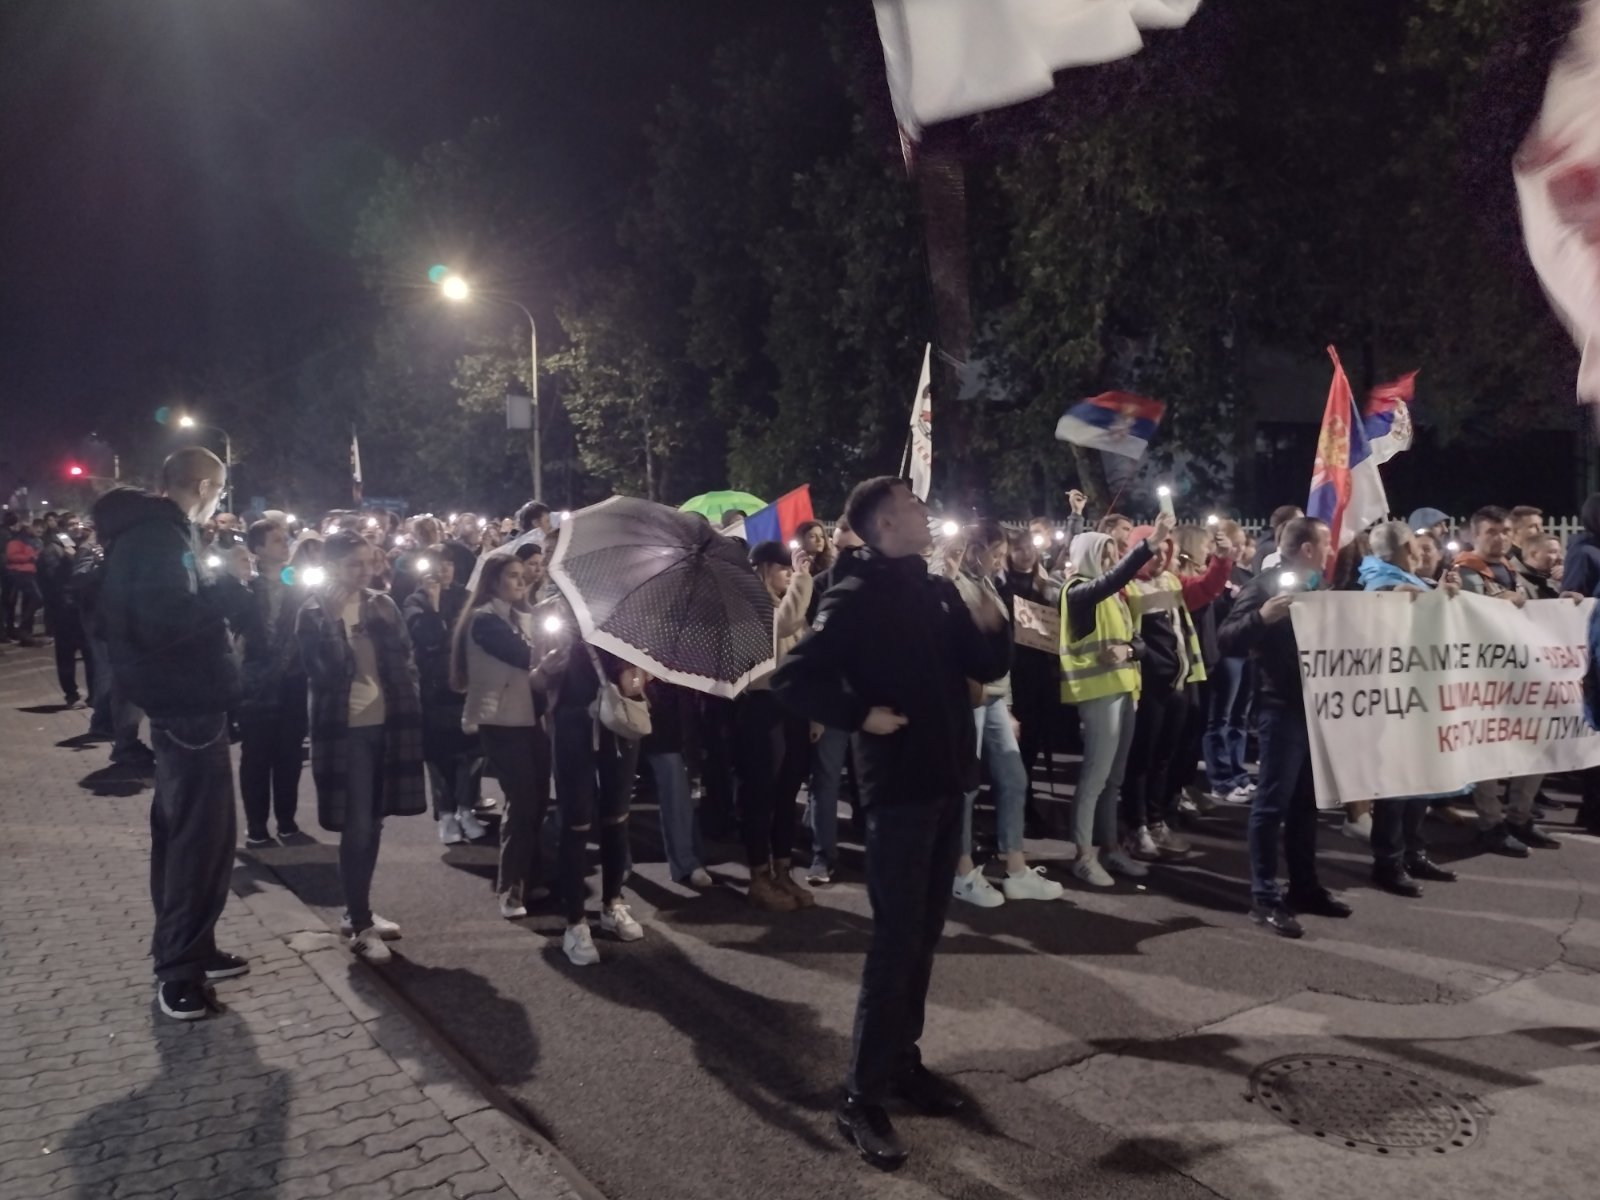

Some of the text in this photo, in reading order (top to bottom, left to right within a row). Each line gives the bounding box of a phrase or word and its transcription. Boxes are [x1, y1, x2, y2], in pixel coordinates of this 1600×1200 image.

[1300, 648, 1382, 678] БЛИЖИ
[1390, 644, 1450, 673] ВАМ
[1476, 643, 1530, 669] КРАЈ
[1314, 691, 1344, 719] ИЗ
[1352, 686, 1428, 719] СРЦА
